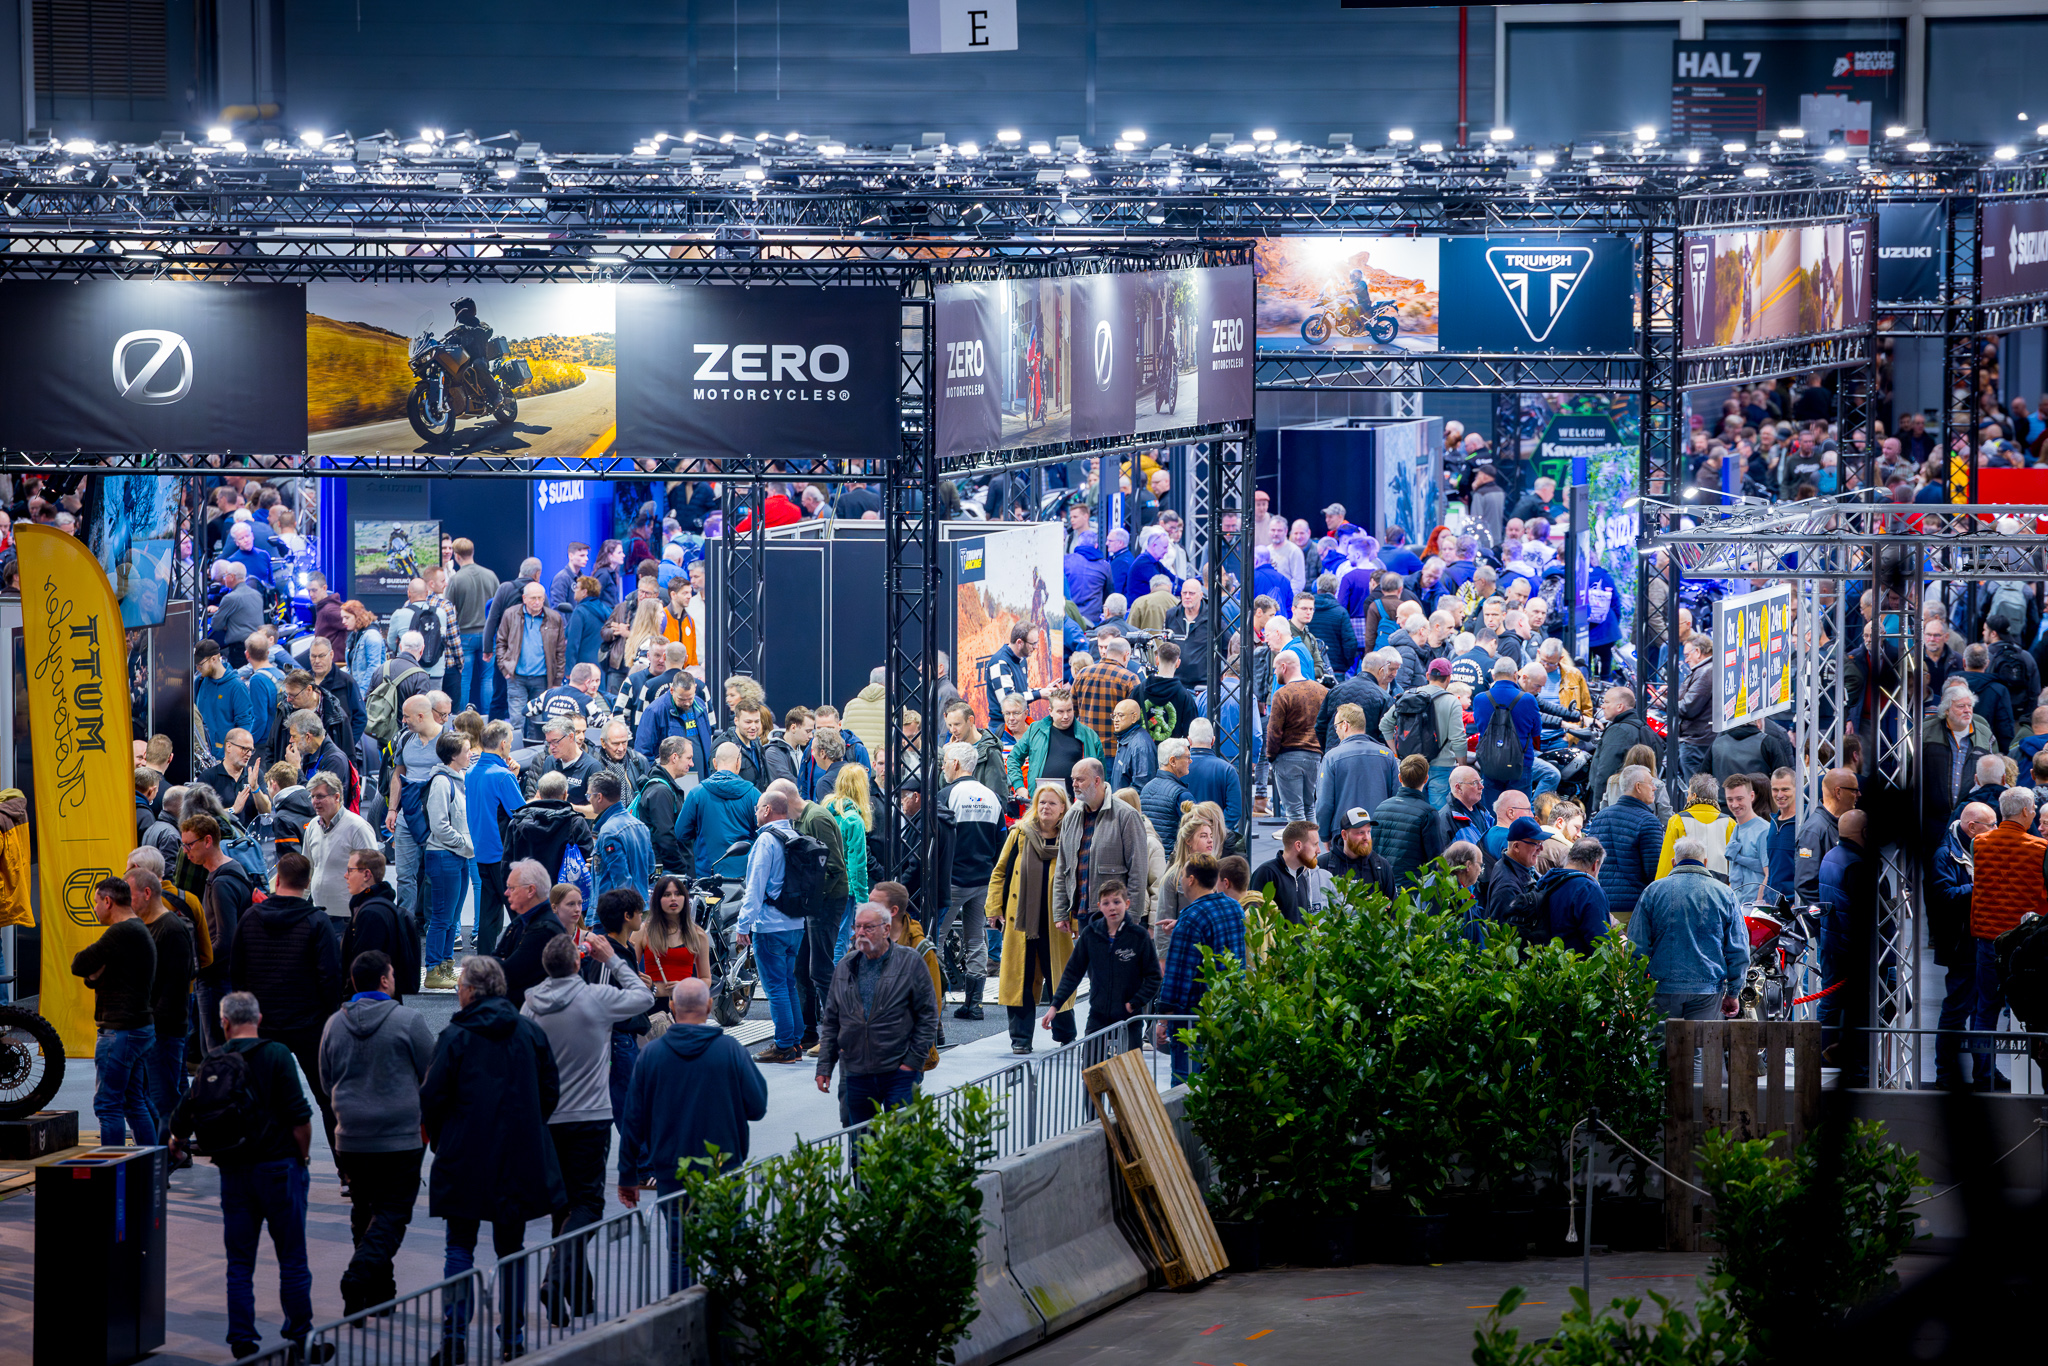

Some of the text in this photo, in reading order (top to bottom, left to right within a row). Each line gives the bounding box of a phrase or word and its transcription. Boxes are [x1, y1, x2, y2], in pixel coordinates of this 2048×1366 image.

[967, 10, 989, 46] E
[1678, 52, 1762, 78] HAL 7
[1853, 51, 1896, 61] MOTOR
[1853, 61, 1896, 70] BEURS
[1505, 254, 1572, 272] TRIUMPH
[1212, 317, 1244, 354] ZERO
[693, 344, 850, 382] ZERO
[946, 339, 985, 379] ZERO
[1558, 428, 1606, 438] WELKOM
[548, 480, 584, 505] SUZUKI
[1727, 617, 1736, 645] 8x
[1749, 610, 1760, 639] 24x
